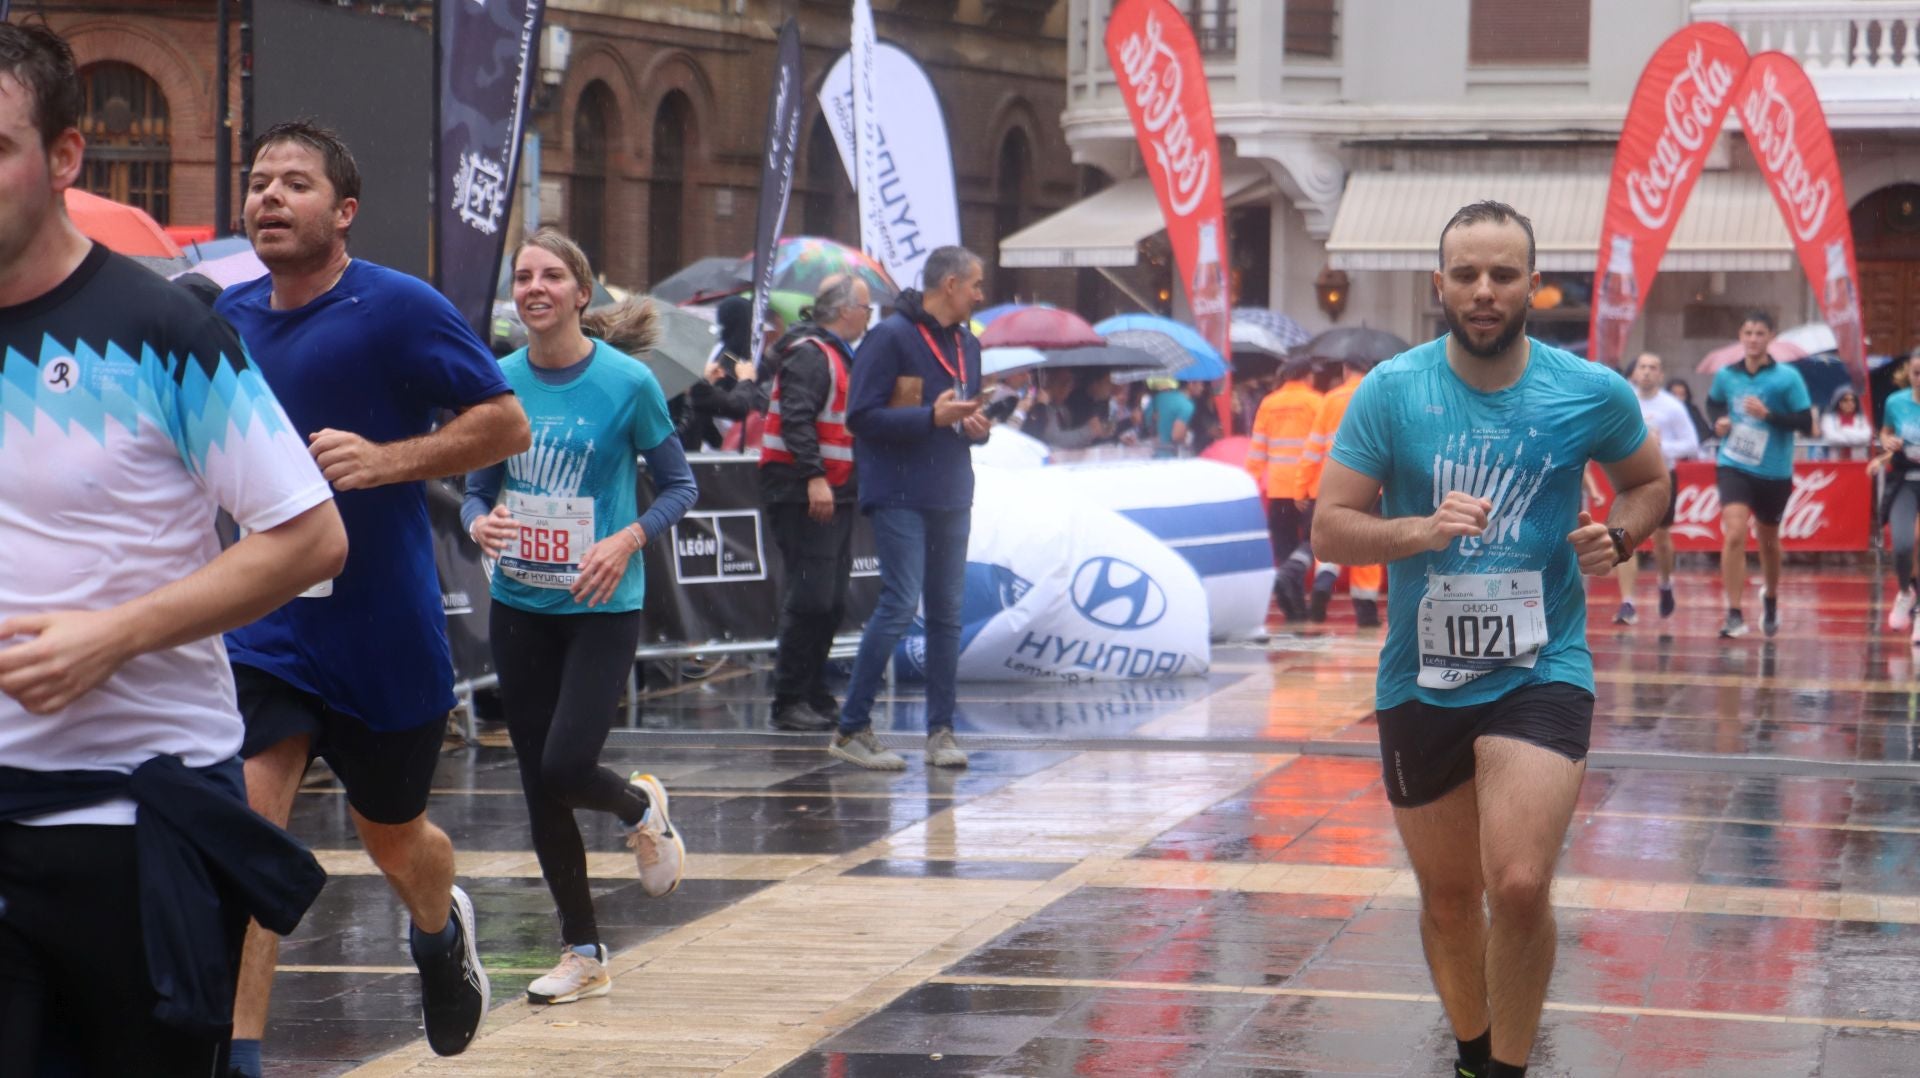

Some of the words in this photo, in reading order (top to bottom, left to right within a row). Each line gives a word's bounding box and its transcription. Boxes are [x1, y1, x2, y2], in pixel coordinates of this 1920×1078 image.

[1626, 40, 1735, 231] Coca-Cola
[520, 526, 569, 562] 668
[679, 533, 716, 556] LEÓN
[724, 562, 756, 572] DEPORTE
[531, 573, 575, 583] HYUNDAI
[1511, 580, 1518, 590] k
[1443, 582, 1451, 592] k
[1462, 604, 1498, 612] CHUCHO
[1445, 615, 1517, 657] 1021
[1016, 631, 1187, 679] HYUNDAI
